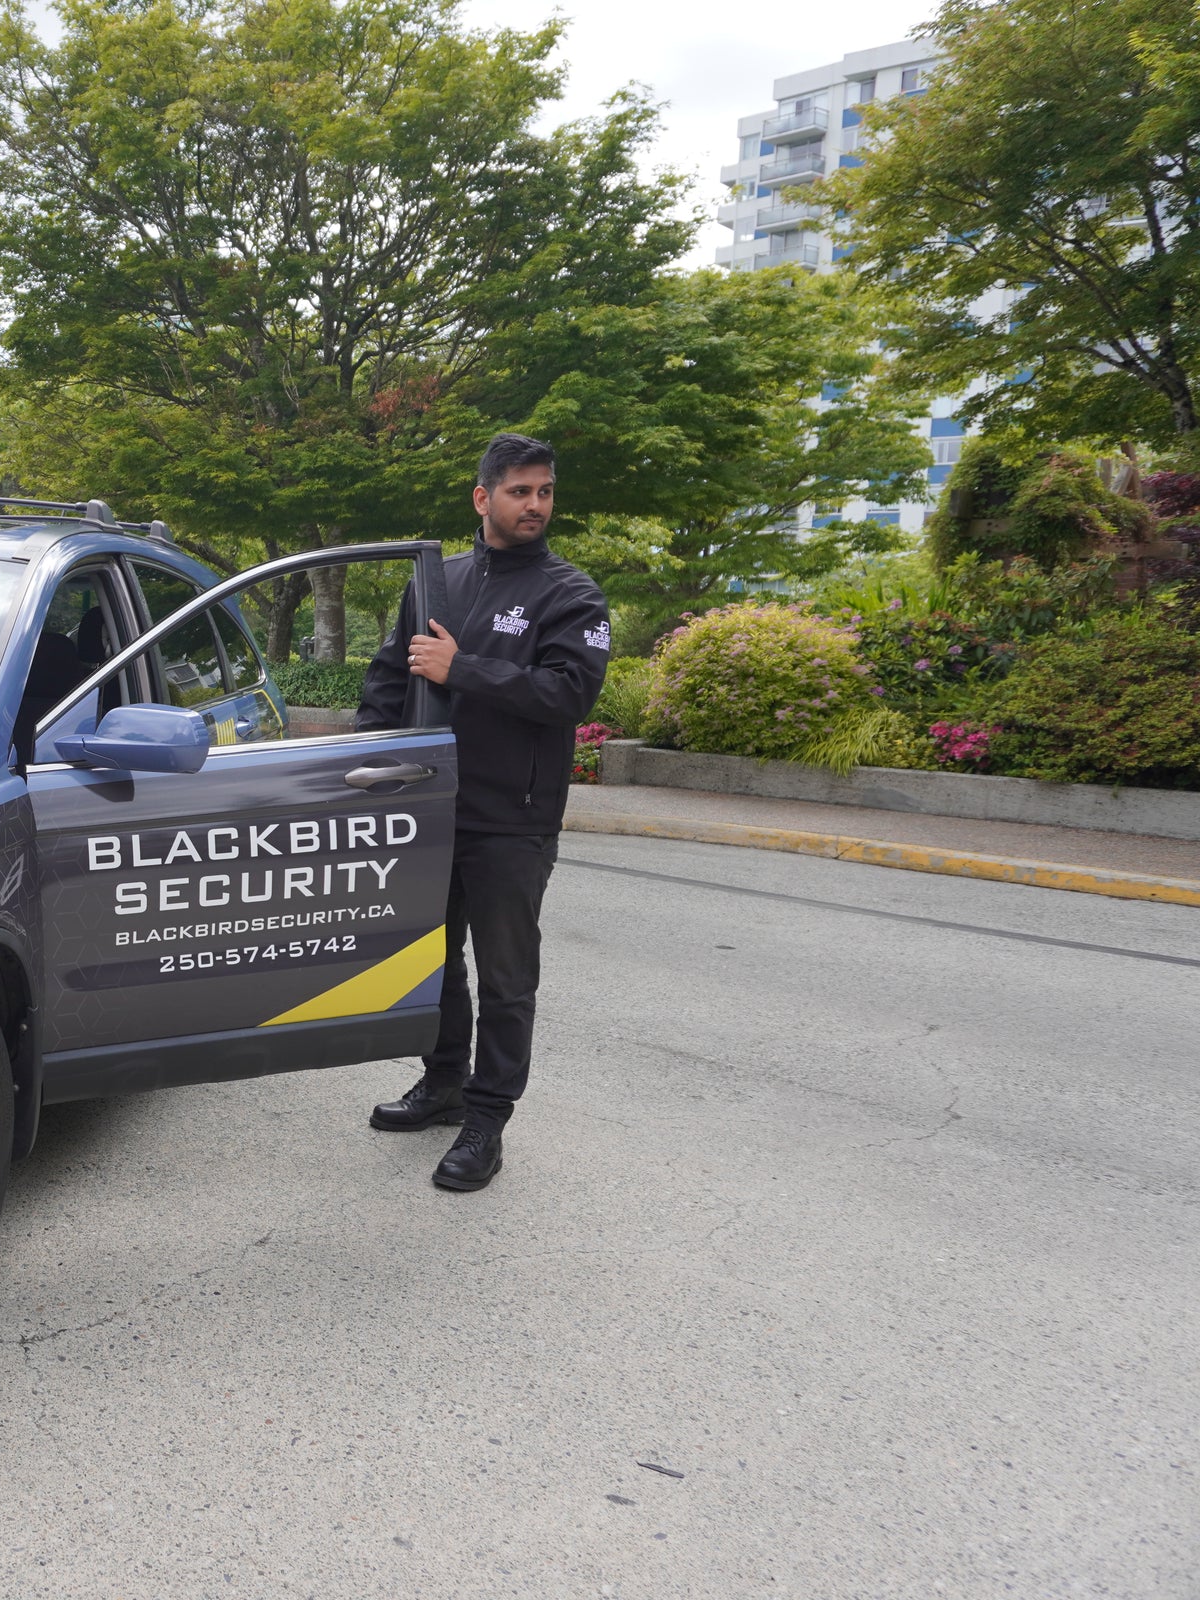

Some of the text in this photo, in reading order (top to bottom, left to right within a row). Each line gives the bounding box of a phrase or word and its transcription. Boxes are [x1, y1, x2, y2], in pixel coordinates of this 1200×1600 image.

[493, 613, 530, 629] BLACKBIRD
[493, 622, 524, 637] SECURITY
[88, 813, 418, 871] BLACKBIRD
[115, 858, 399, 916] SECURITY
[116, 903, 396, 946] BLACKBIRDSECURITY.CA
[160, 935, 357, 973] 250-574-5742
